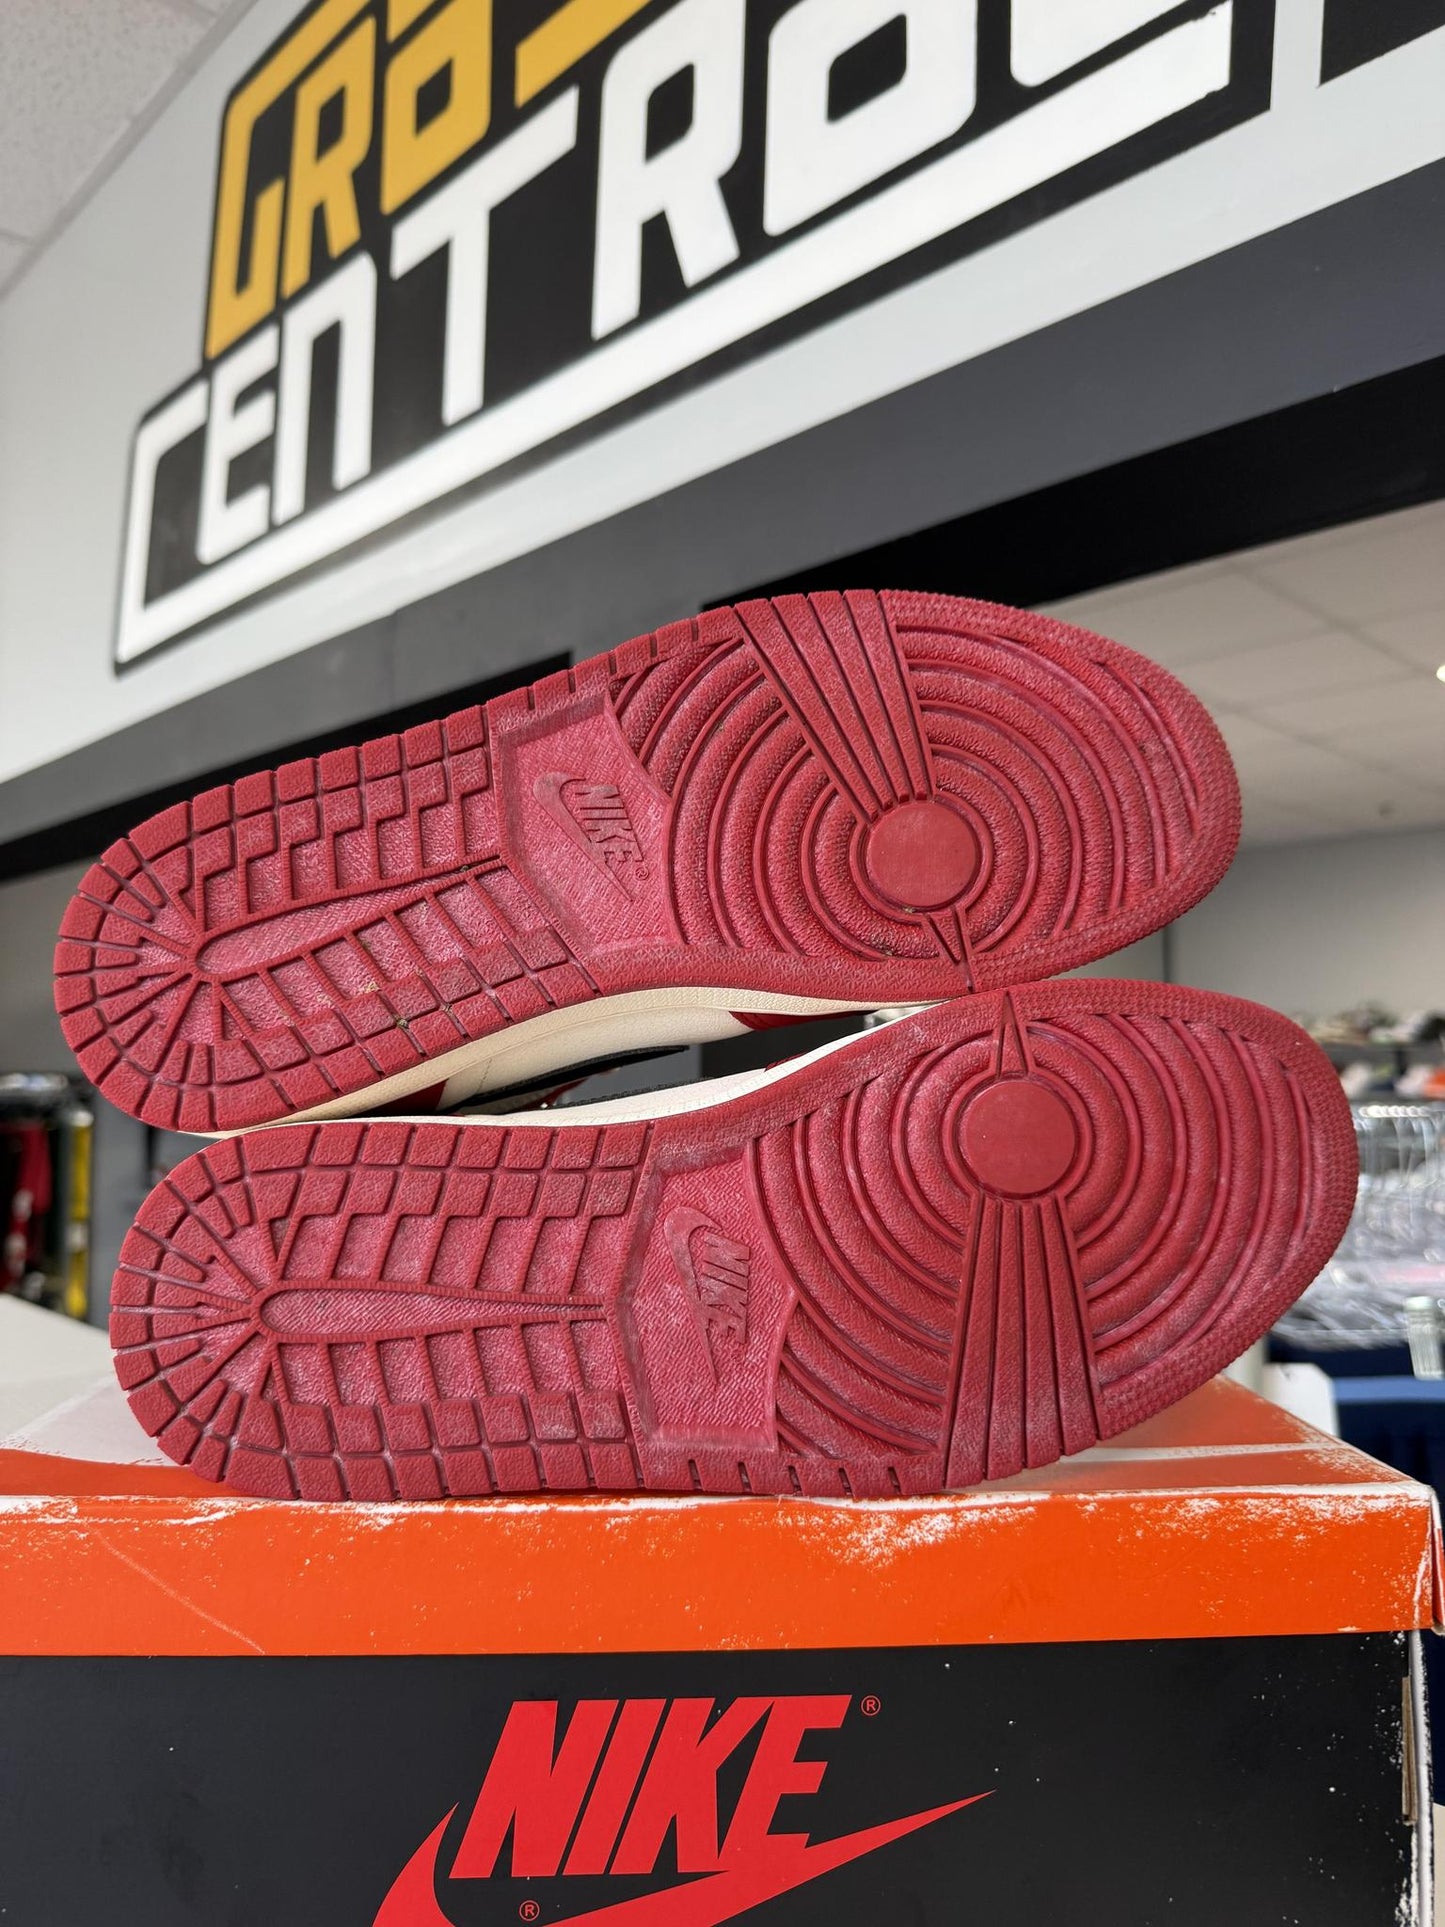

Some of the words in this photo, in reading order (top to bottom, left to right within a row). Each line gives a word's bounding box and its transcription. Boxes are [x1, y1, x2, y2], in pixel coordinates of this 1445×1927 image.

[574, 784, 645, 863] NIKE
[700, 1231, 751, 1345] NIKE
[449, 1695, 853, 1879] NIKE
